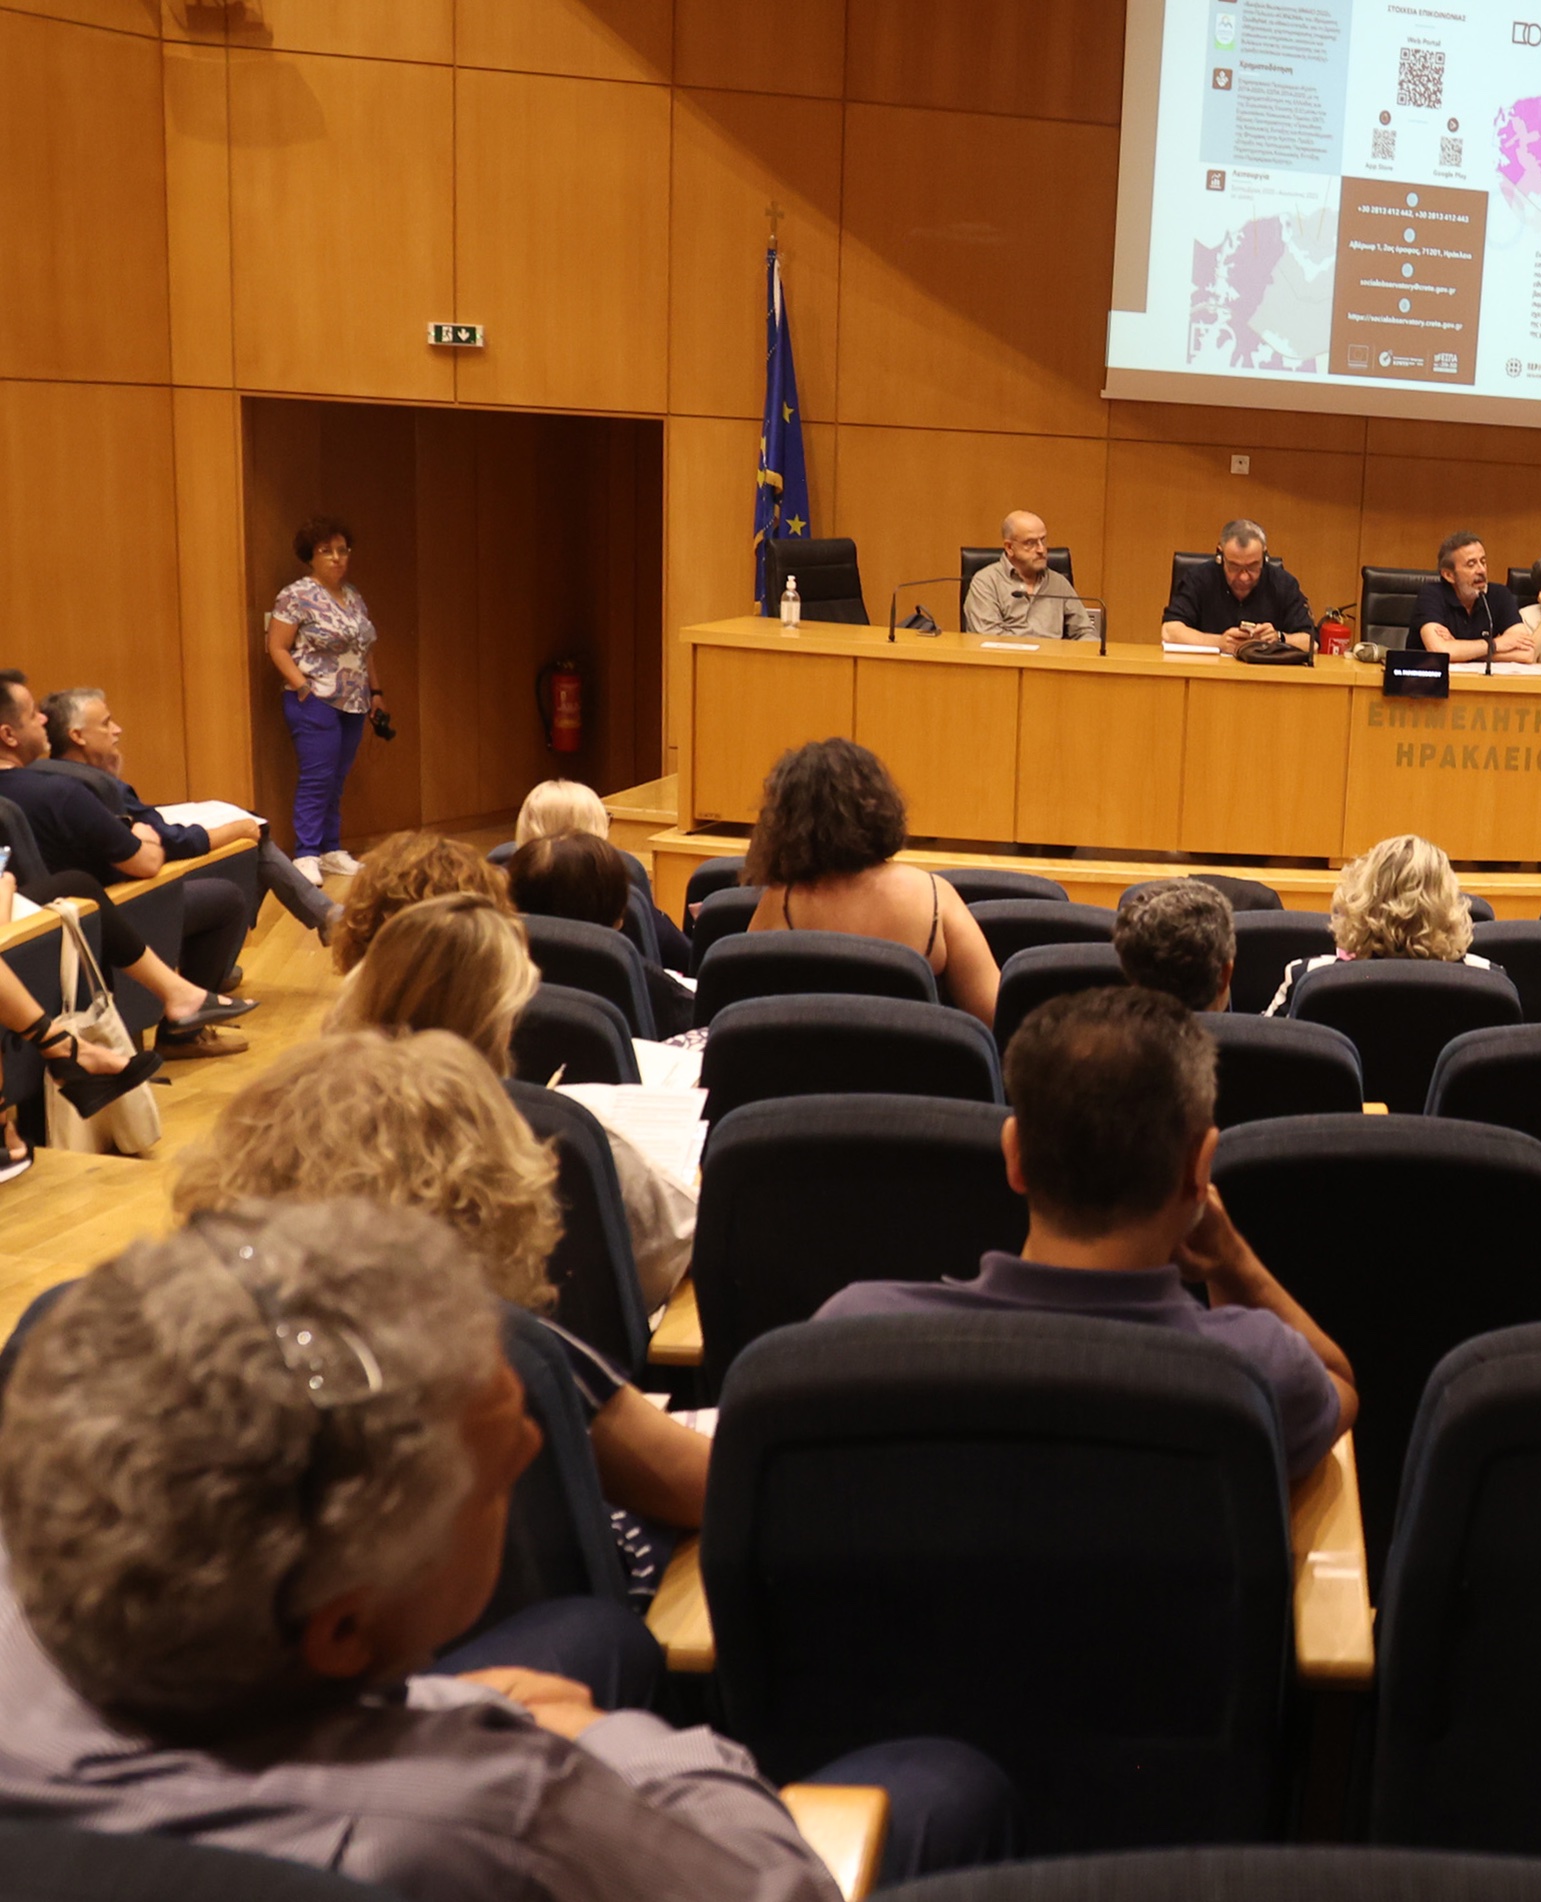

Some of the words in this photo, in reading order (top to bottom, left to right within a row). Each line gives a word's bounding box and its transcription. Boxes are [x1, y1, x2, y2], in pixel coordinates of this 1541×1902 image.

[1407, 36, 1421, 45] Web
[1423, 38, 1442, 47] Portal
[1365, 162, 1377, 171] App
[1378, 164, 1394, 172] Store
[1432, 169, 1454, 179] Google
[1455, 171, 1467, 180] Play
